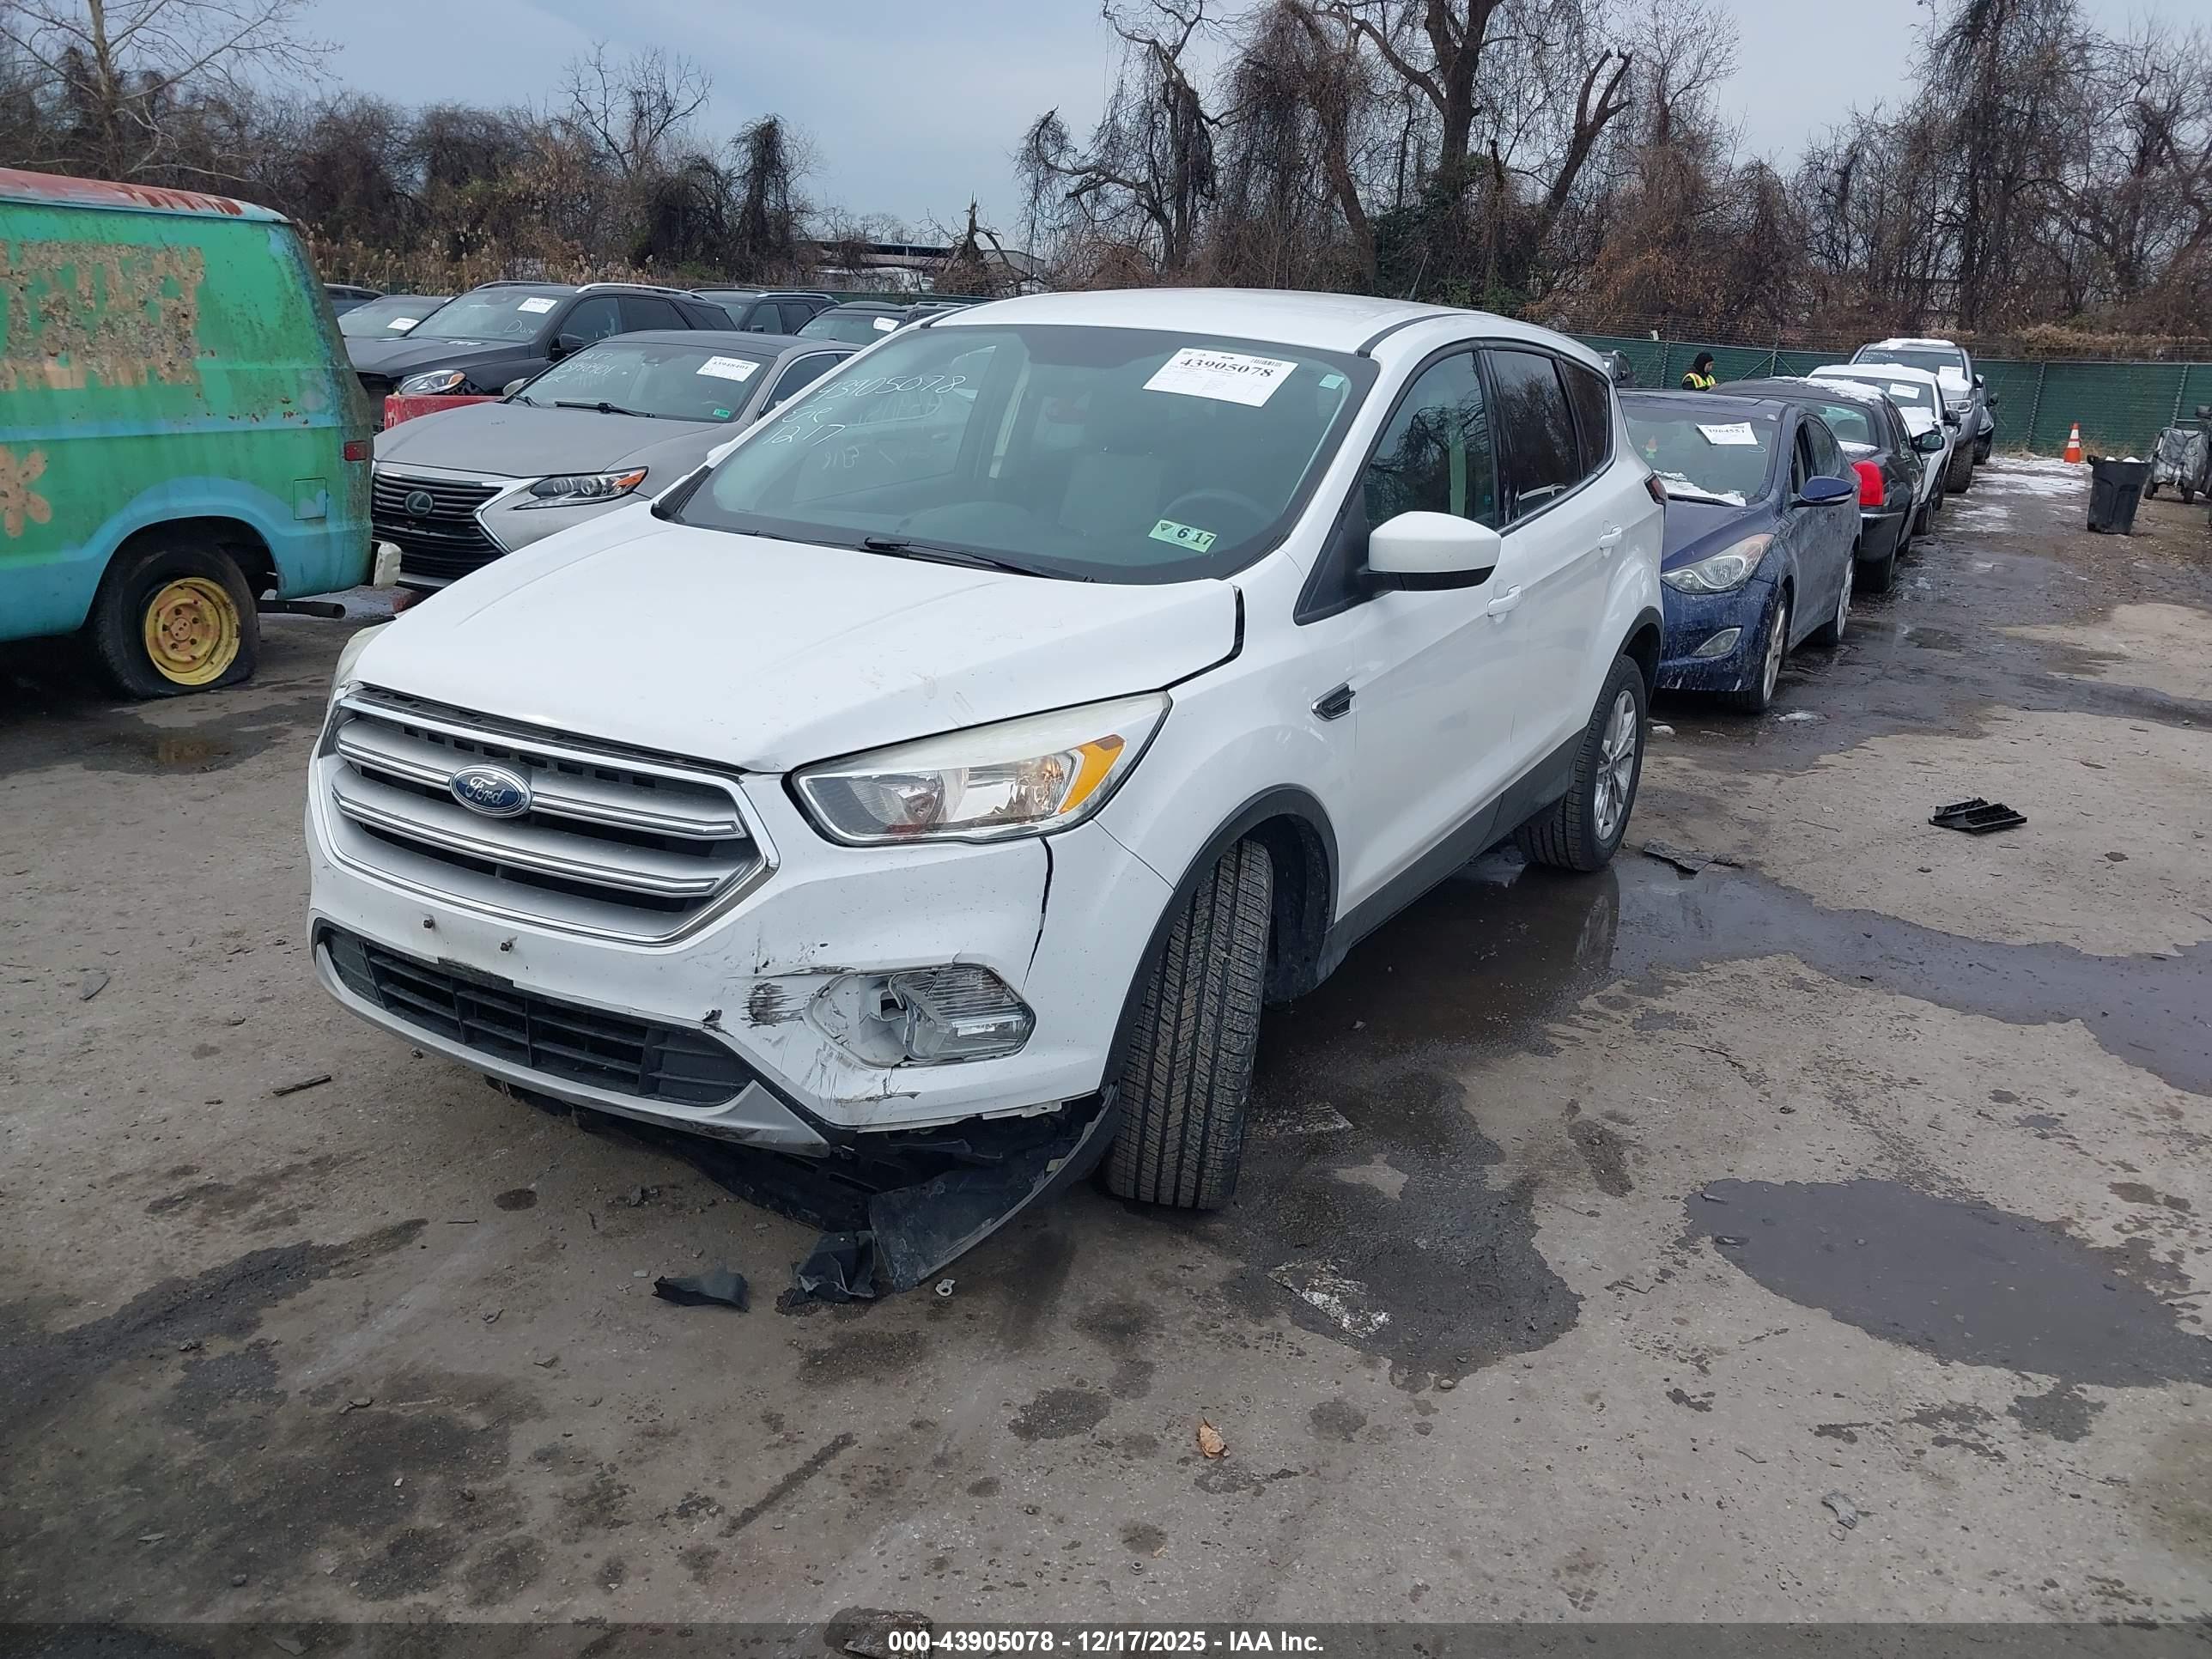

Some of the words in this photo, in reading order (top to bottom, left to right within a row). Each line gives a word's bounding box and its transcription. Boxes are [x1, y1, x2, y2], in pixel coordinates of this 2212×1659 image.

[1180, 358, 1274, 378] 43905078
[812, 374, 967, 403] 43905078
[762, 424, 846, 447] 1217
[1176, 527, 1190, 538] 6
[1192, 532, 1215, 545] 17
[465, 776, 506, 805] Ford
